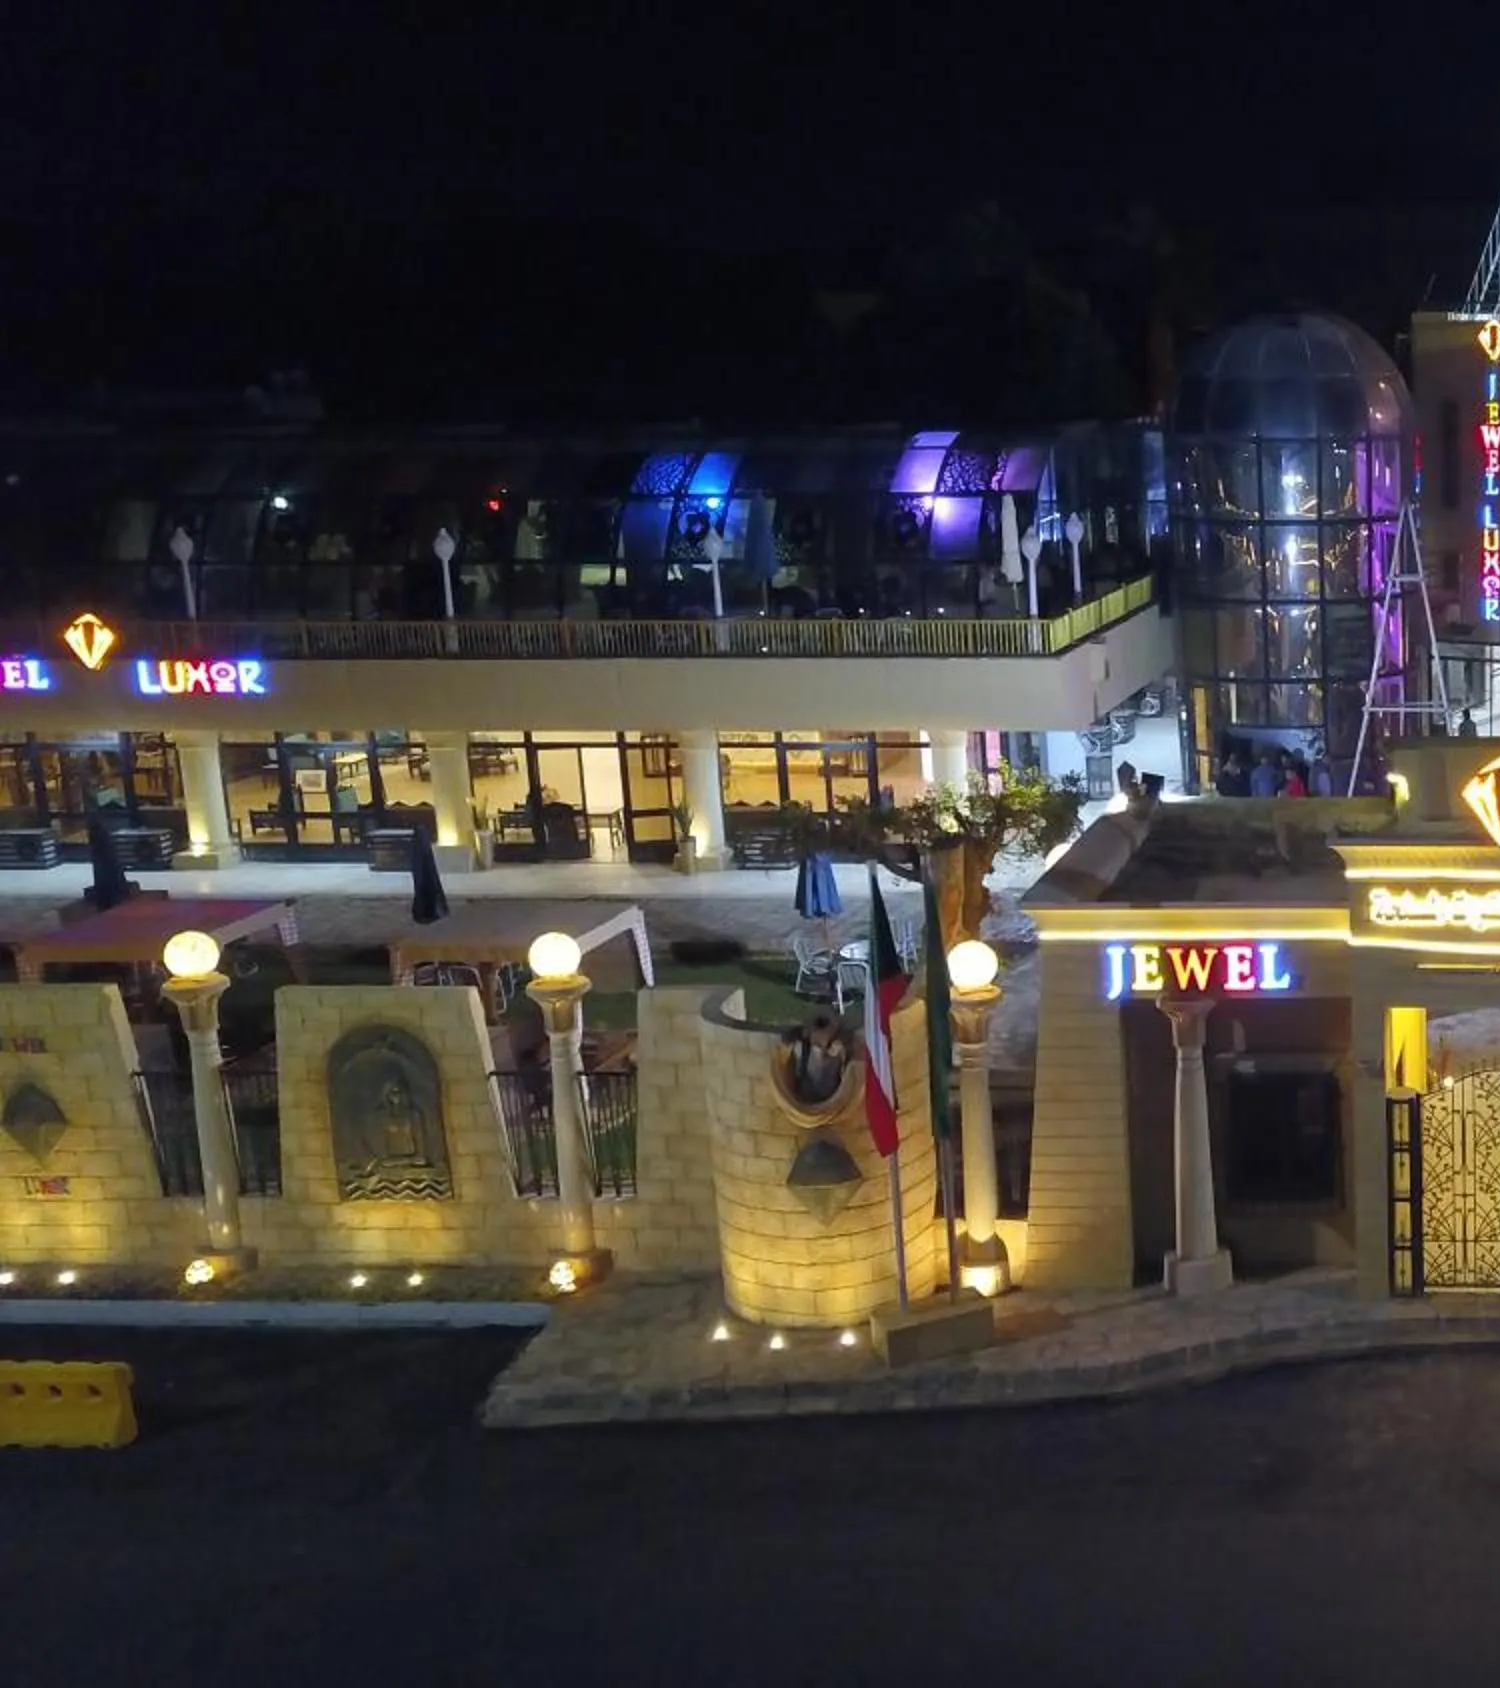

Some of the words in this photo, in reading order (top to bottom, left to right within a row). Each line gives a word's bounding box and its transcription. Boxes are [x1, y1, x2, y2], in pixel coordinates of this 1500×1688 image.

[1482, 505, 1500, 621] LUXOR
[136, 660, 266, 694] LUXOR
[1105, 944, 1290, 1000] JEWEL
